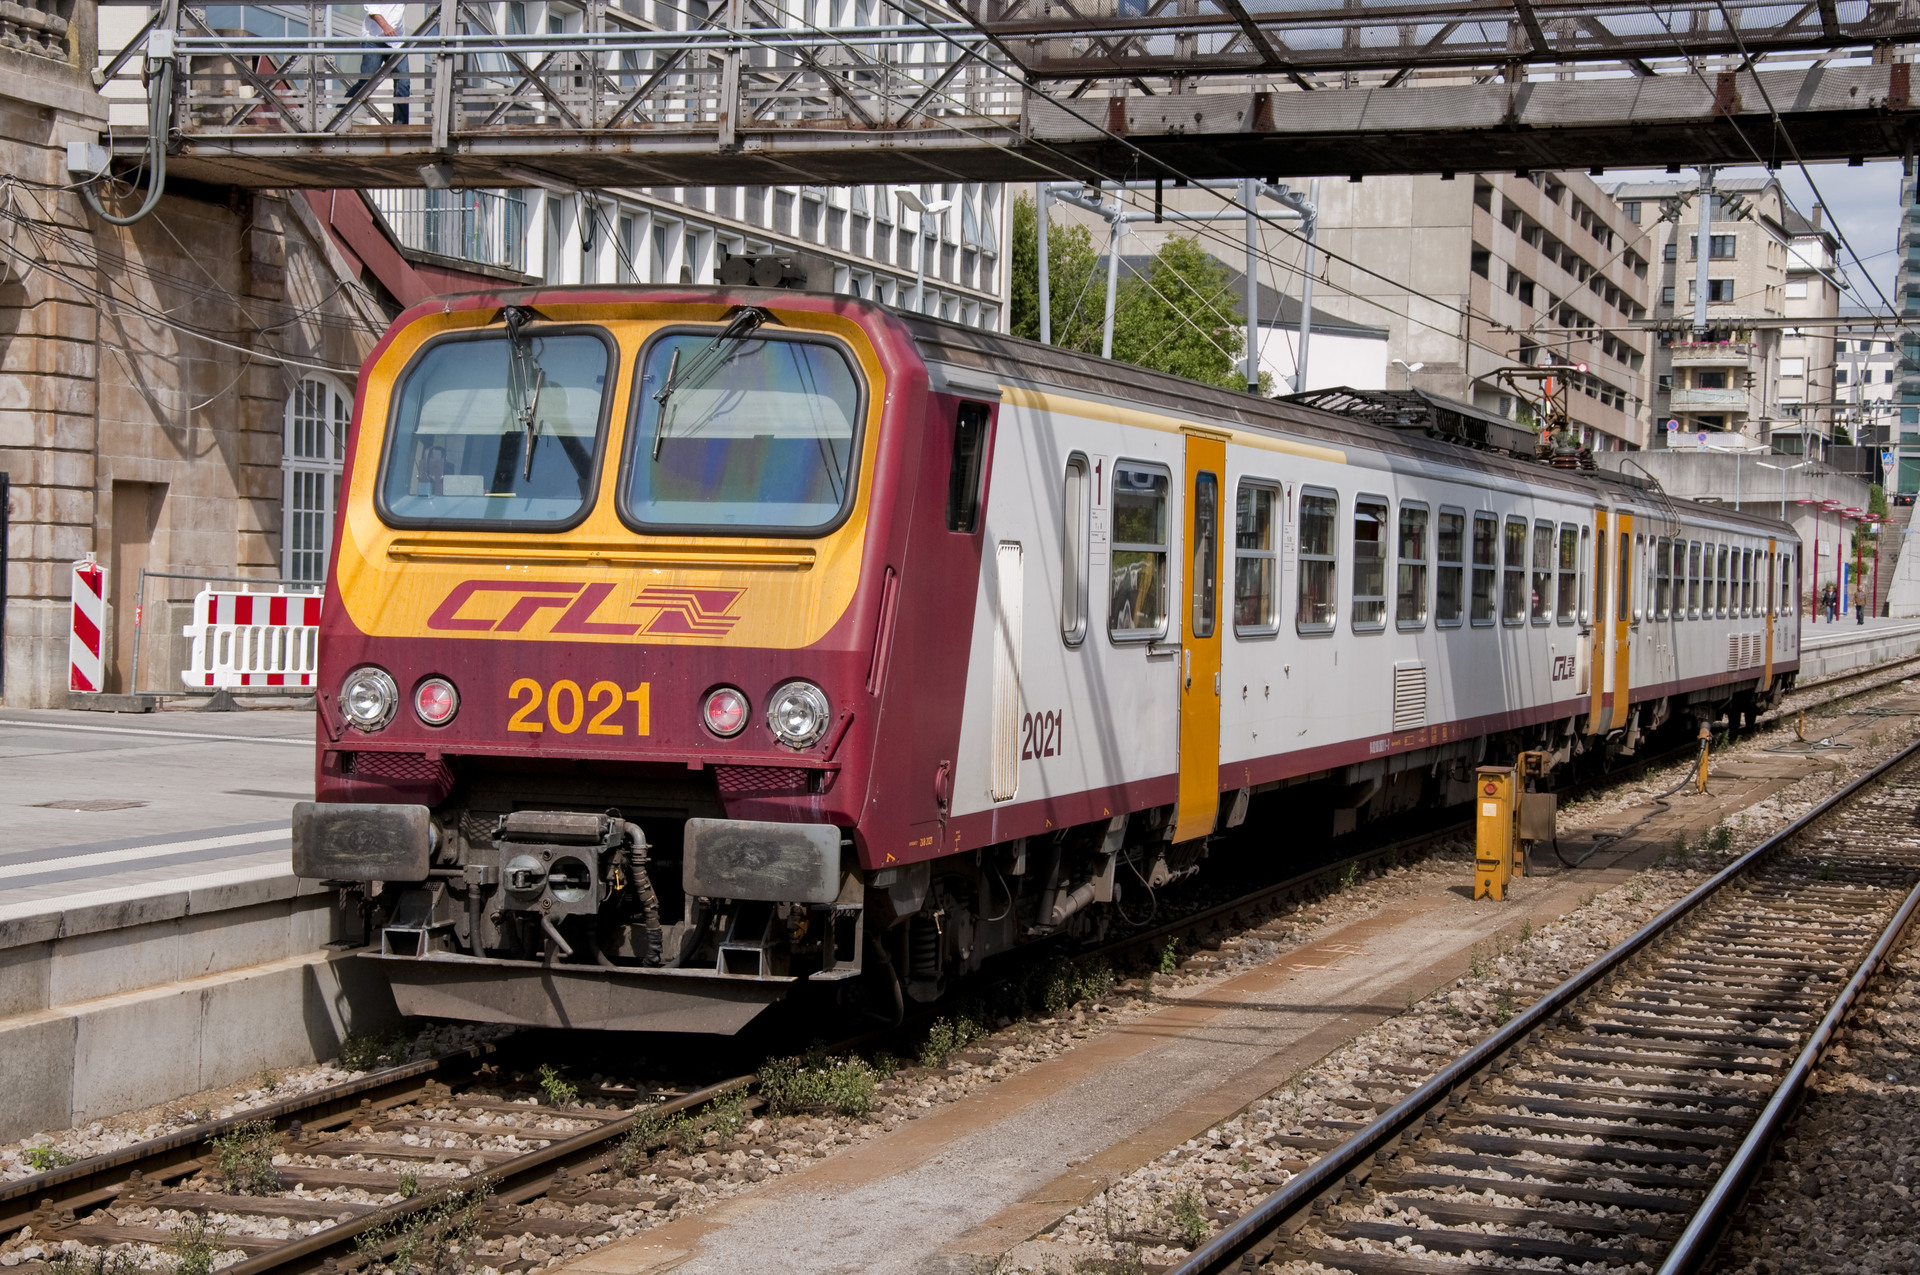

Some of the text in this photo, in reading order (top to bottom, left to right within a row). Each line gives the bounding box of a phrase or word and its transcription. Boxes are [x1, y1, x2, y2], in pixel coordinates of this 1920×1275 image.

[1095, 459, 1102, 506] 1
[427, 580, 642, 635] CFL
[1552, 655, 1569, 681] CFL
[507, 678, 650, 736] 2021
[1022, 709, 1062, 761] 2021
